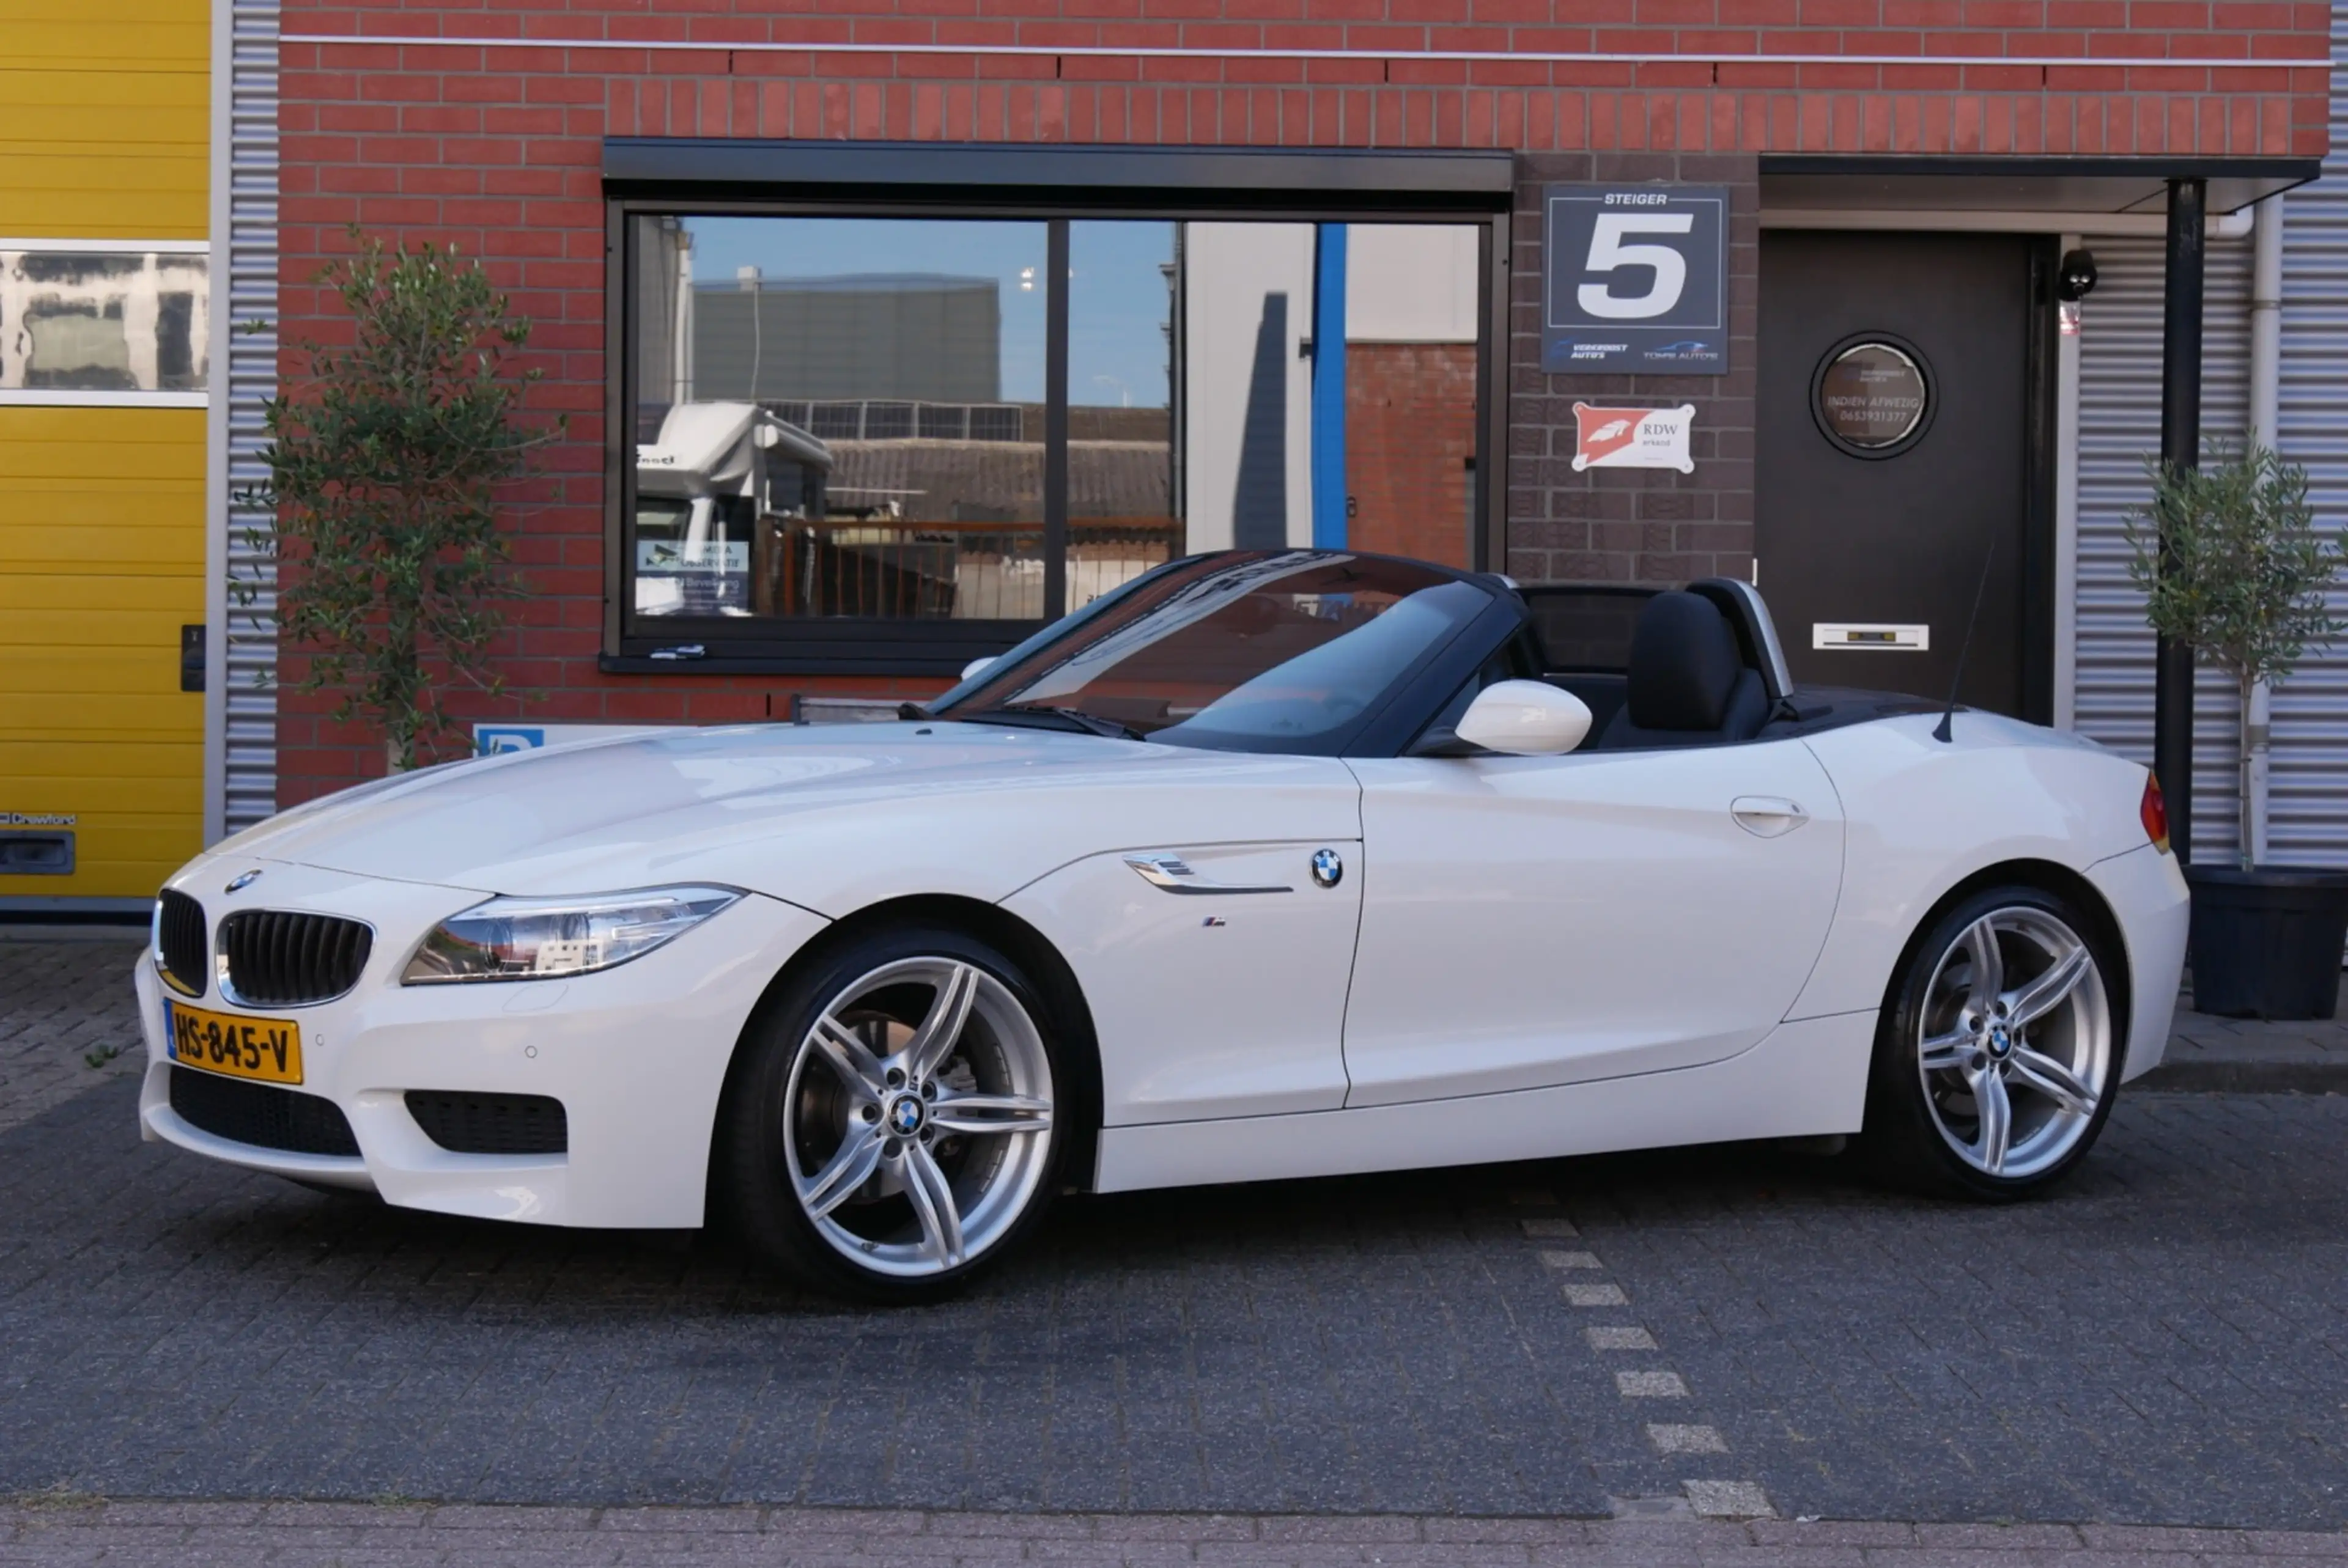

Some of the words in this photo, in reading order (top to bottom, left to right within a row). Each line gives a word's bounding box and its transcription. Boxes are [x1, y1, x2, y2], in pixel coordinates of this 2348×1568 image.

[1604, 193, 1667, 205] STEIGER
[1578, 213, 1694, 318] 5
[1644, 424, 1678, 435] RDW
[175, 1012, 288, 1072] HS-845-V
